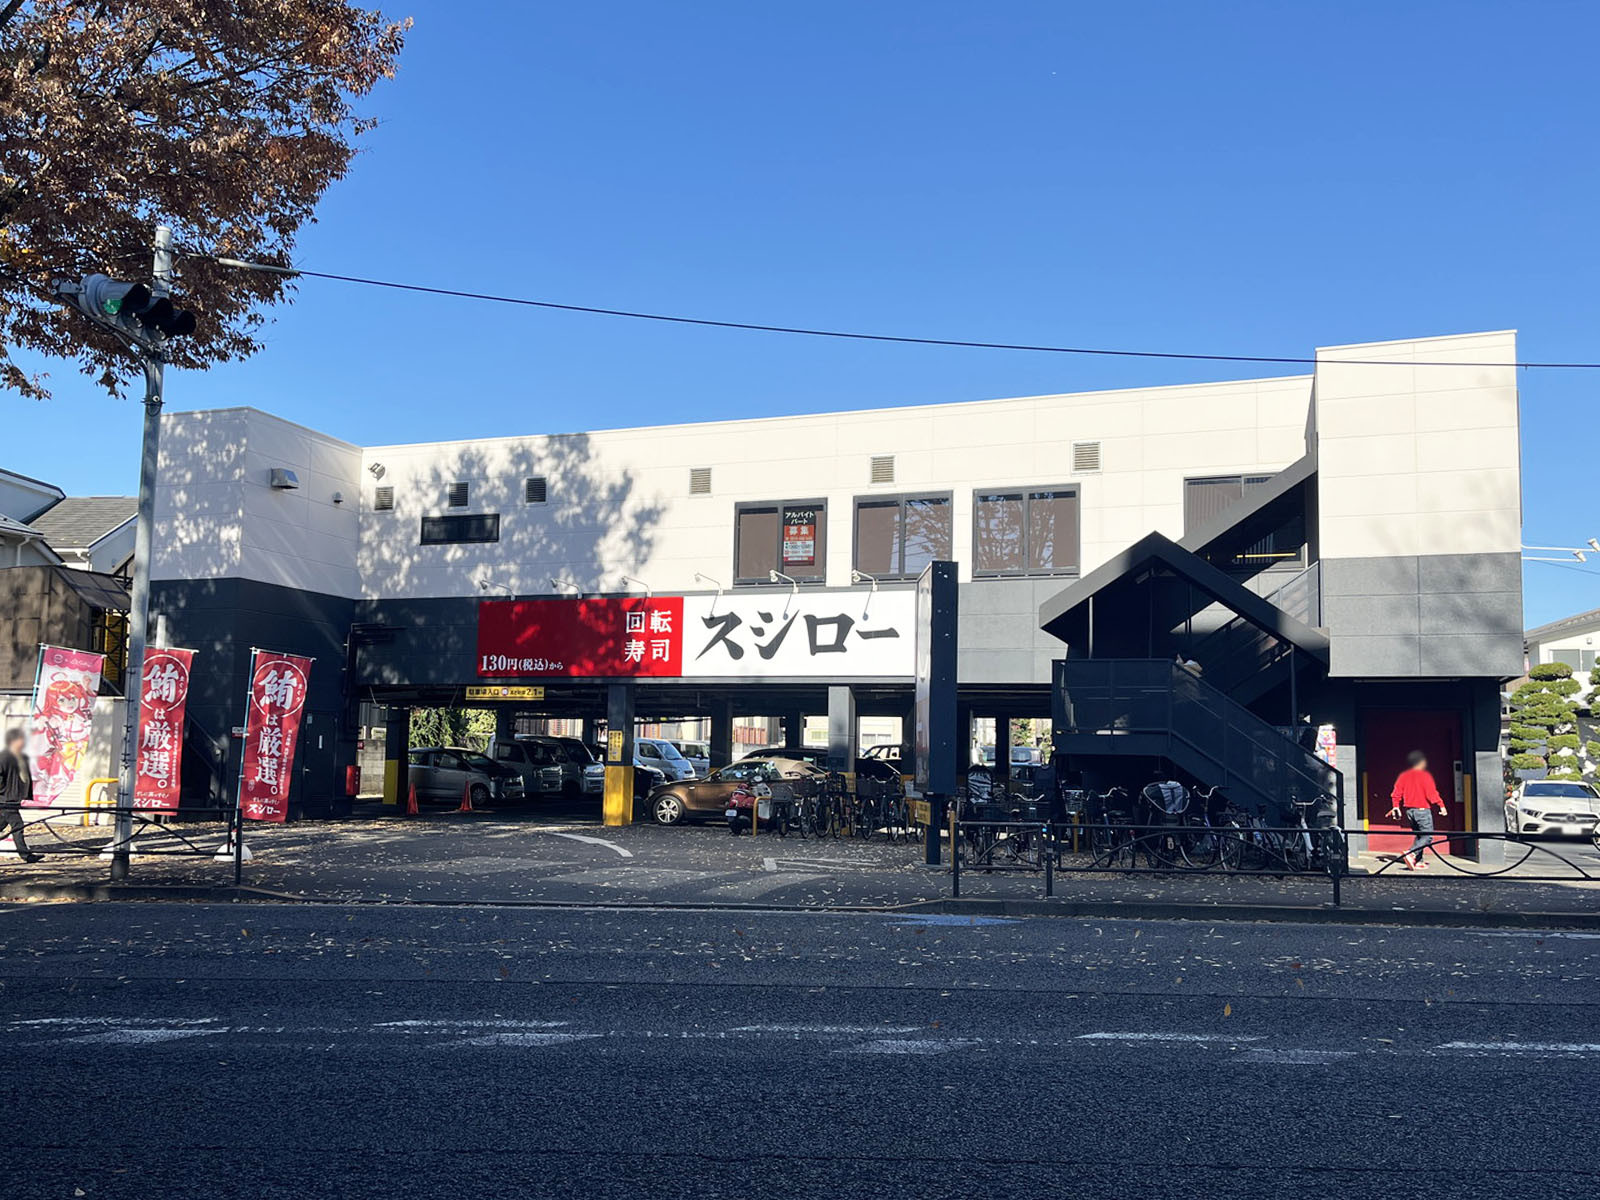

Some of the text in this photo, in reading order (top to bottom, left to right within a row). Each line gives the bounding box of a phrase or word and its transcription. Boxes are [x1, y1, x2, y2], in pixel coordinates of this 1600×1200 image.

[626, 609, 672, 633] 回転
[695, 609, 900, 661] スシロー
[624, 638, 670, 662] 寿司
[481, 654, 564, 671] 130円(税込)から
[133, 798, 170, 808] スシロー
[246, 803, 280, 815] スシロー
